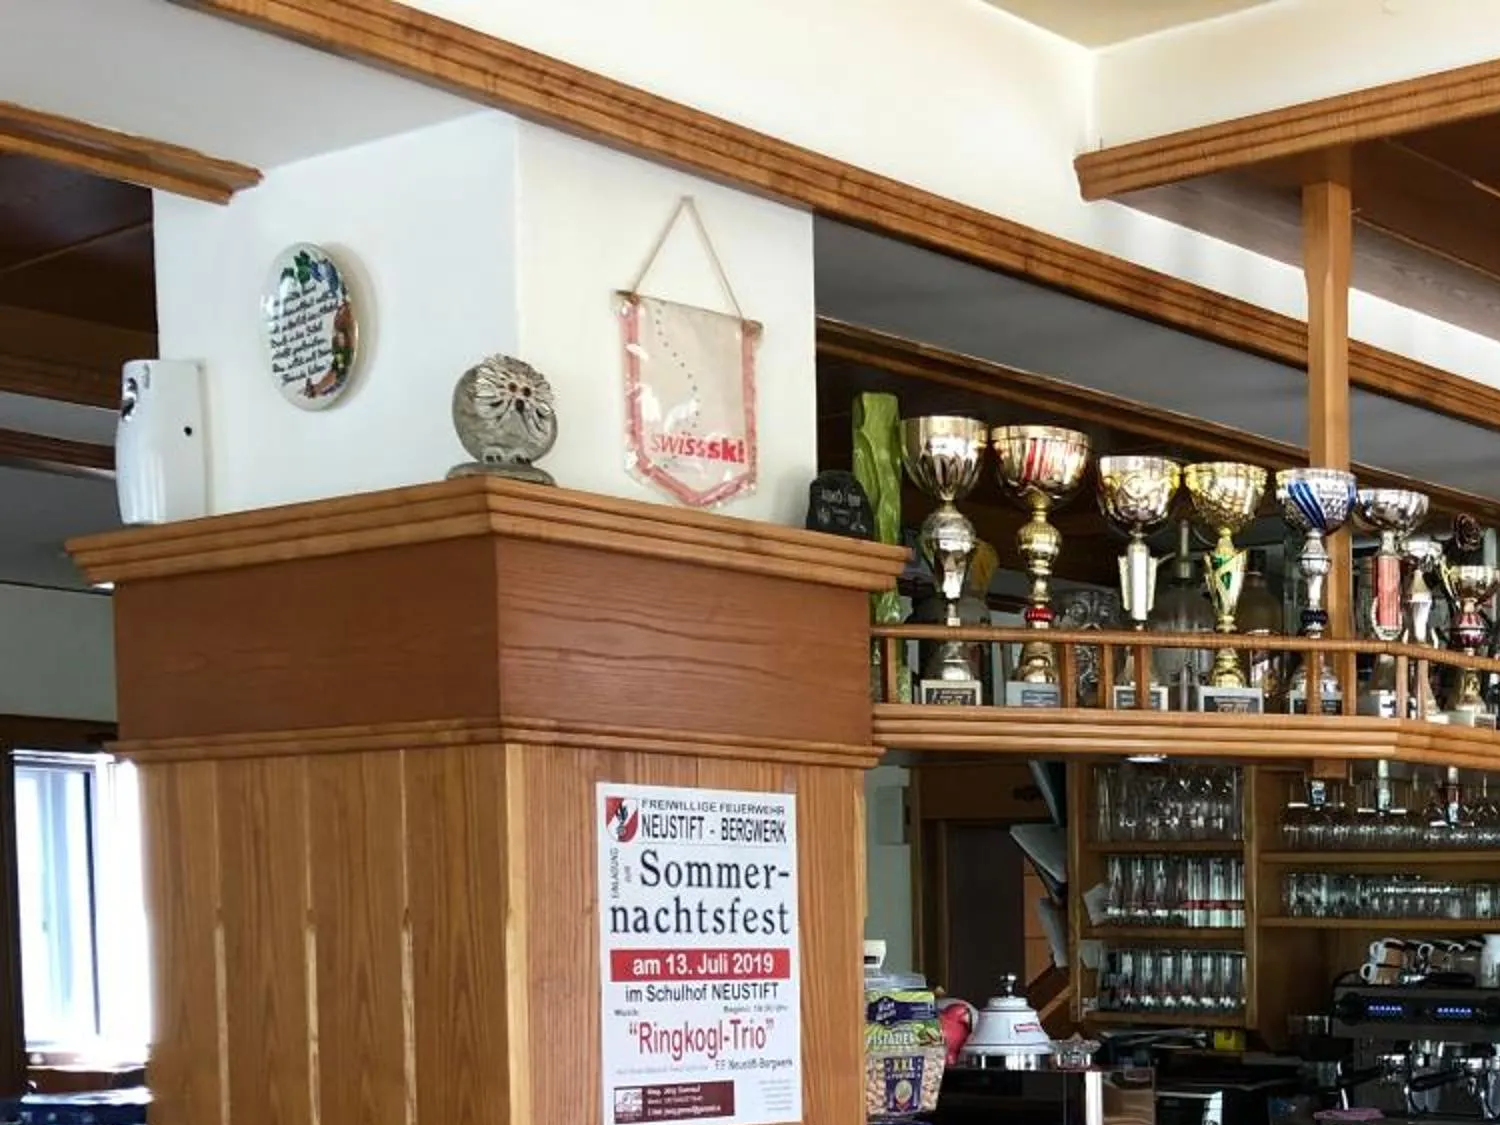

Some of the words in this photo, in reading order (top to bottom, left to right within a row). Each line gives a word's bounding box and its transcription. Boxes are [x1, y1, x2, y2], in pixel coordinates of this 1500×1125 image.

[641, 799, 717, 813] FREIWILLIGE
[719, 804, 785, 815] FEUERWEHR
[641, 814, 705, 839] NEUSTIFT
[721, 817, 787, 843] BERGWERK
[640, 849, 790, 890] Sommer-
[610, 895, 791, 935] nachtsfest
[633, 958, 661, 976] am
[665, 954, 693, 976] 13.
[697, 953, 729, 974] Juli
[733, 952, 774, 975] 2019
[625, 984, 643, 1002] im
[646, 984, 709, 1002] Schulhof
[711, 982, 779, 1000] NEUSTIFT
